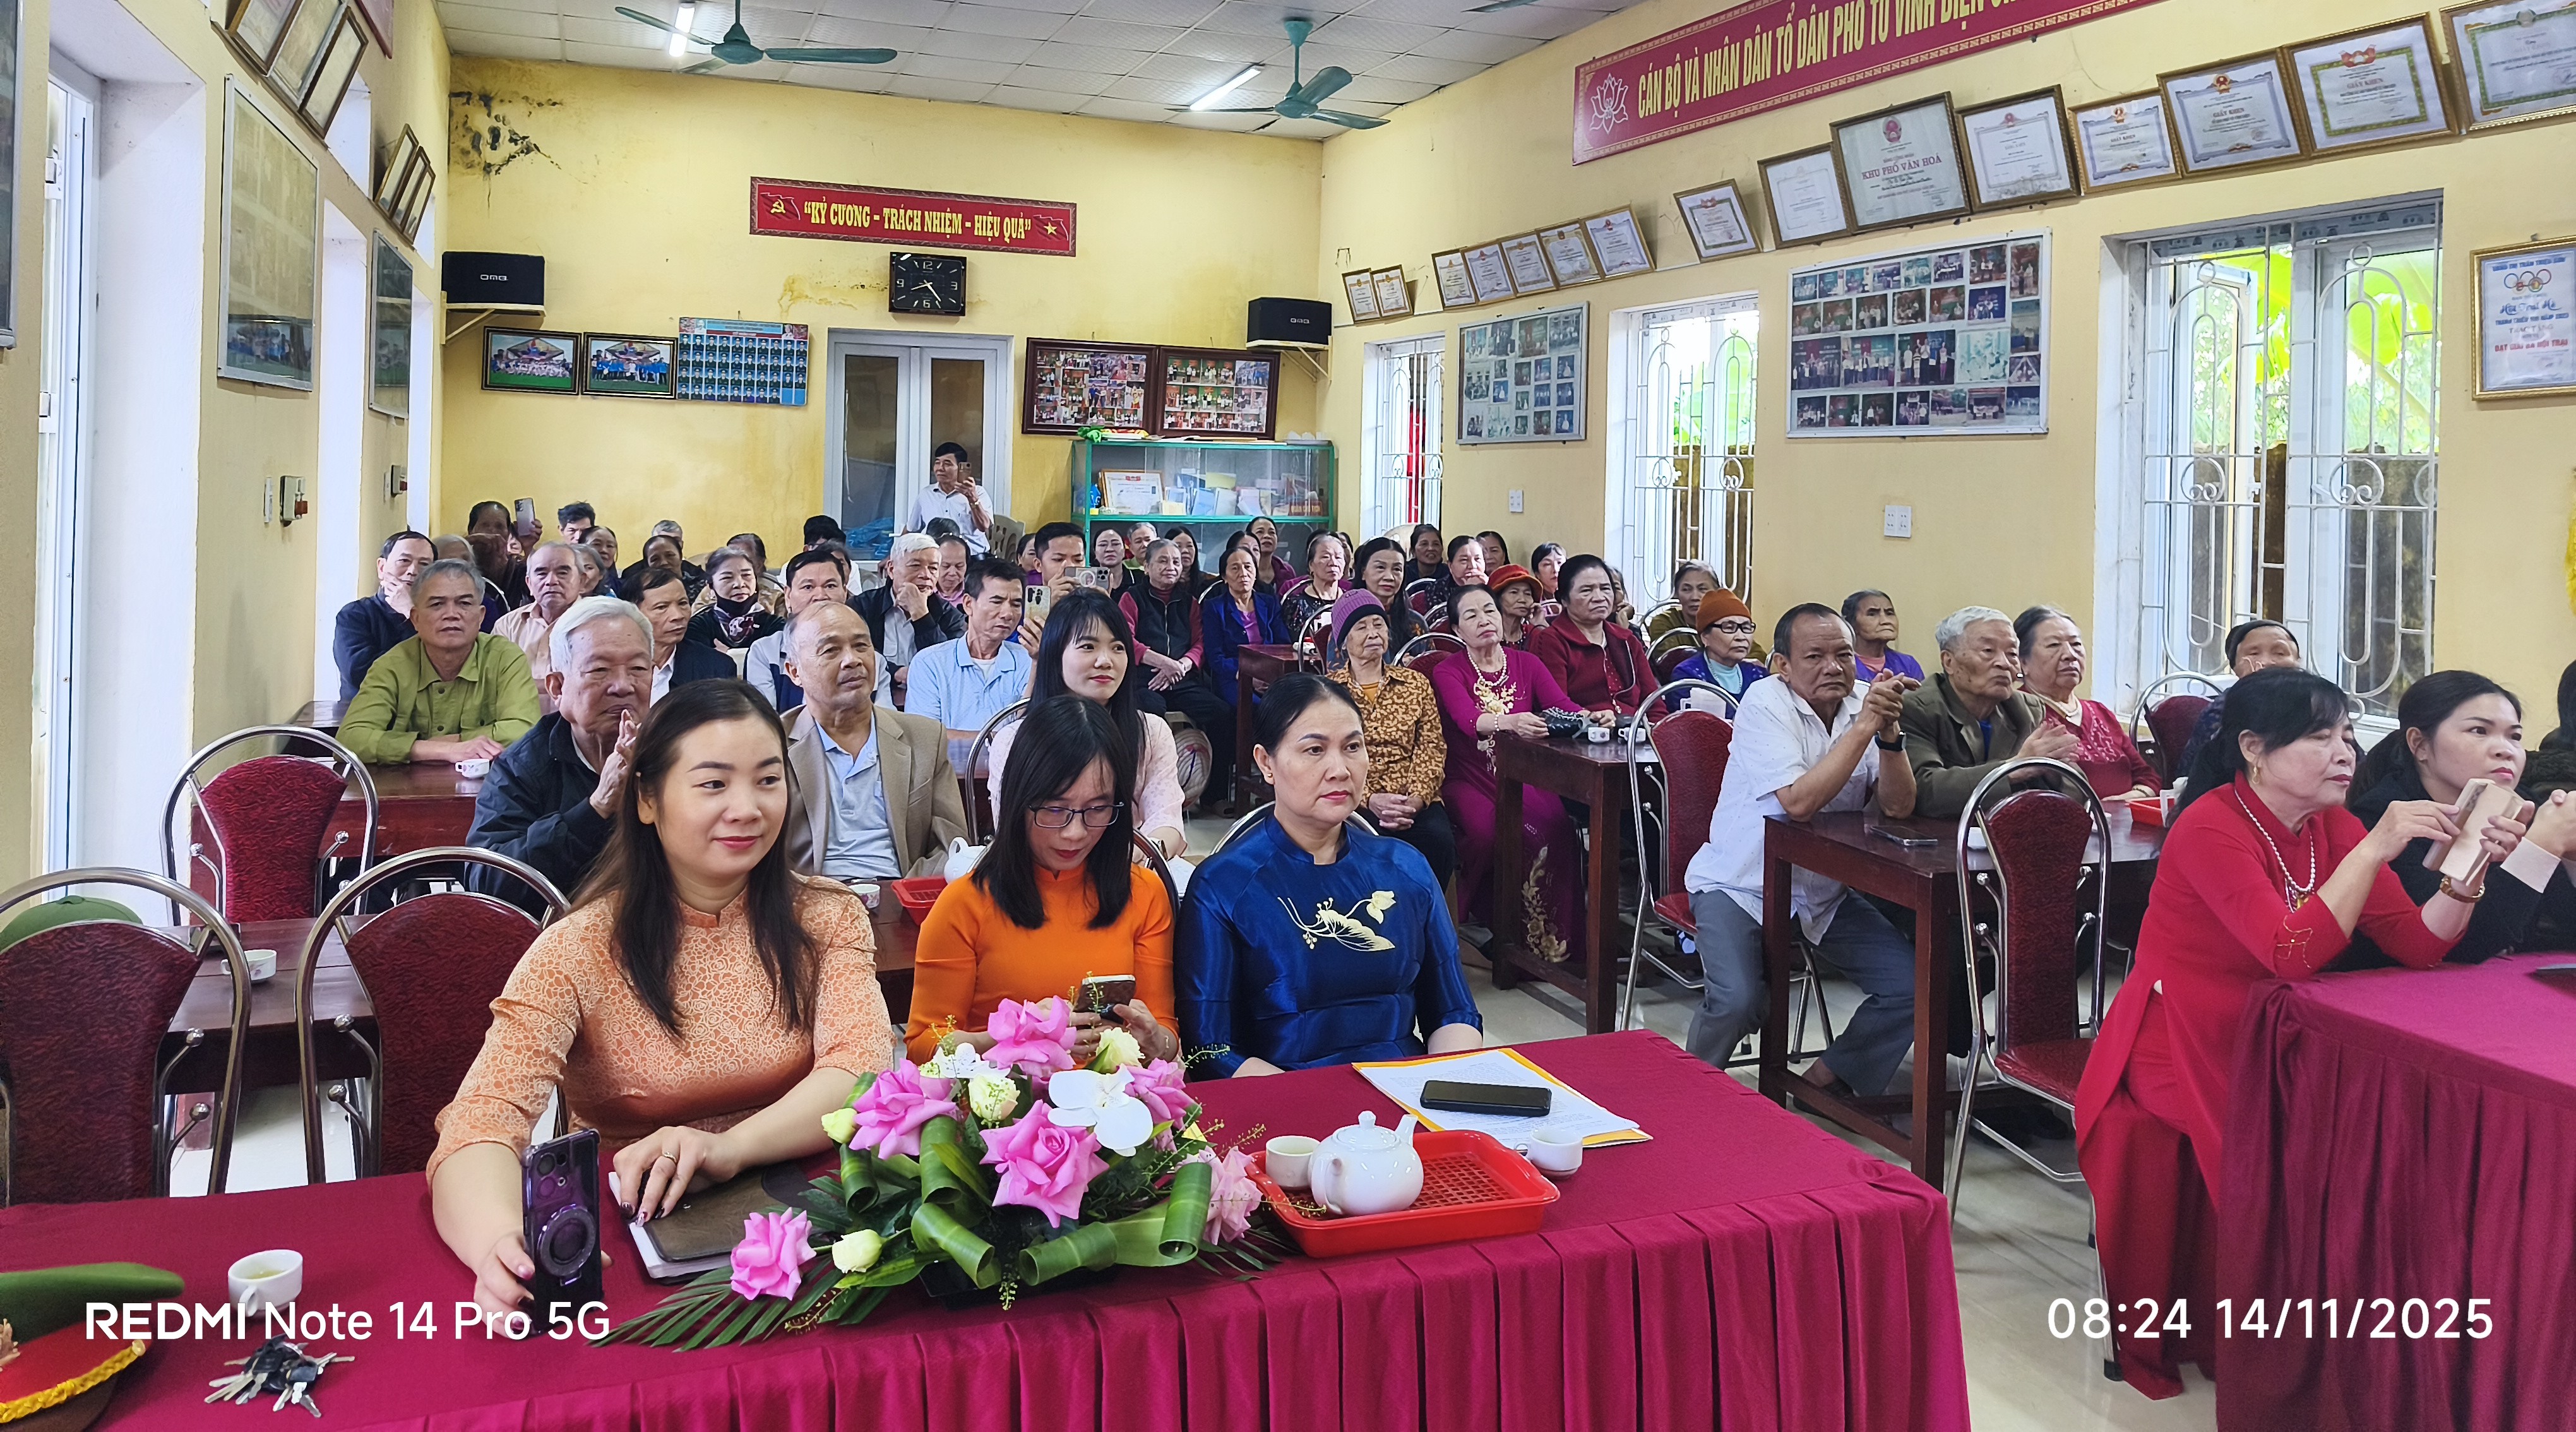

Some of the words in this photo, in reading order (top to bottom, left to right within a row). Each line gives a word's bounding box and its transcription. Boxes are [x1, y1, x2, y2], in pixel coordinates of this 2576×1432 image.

[1638, 63, 1662, 118] CÁN
[1665, 53, 1681, 118] BỘ
[1685, 47, 1699, 104] VÀ
[1703, 36, 1739, 98] NHÂN
[1743, 25, 1772, 86] DÂN
[1776, 2, 1794, 73] TỔ
[1797, 4, 1828, 68] DÂN
[1861, 169, 1880, 180] KHU
[1882, 162, 1899, 175] PHỐ
[1901, 158, 1920, 171] VĂN
[830, 205, 871, 228] CƯƠNG
[883, 203, 921, 232] TRÁCH
[924, 207, 962, 239] NHIỆM
[974, 211, 1000, 241] HIỆU
